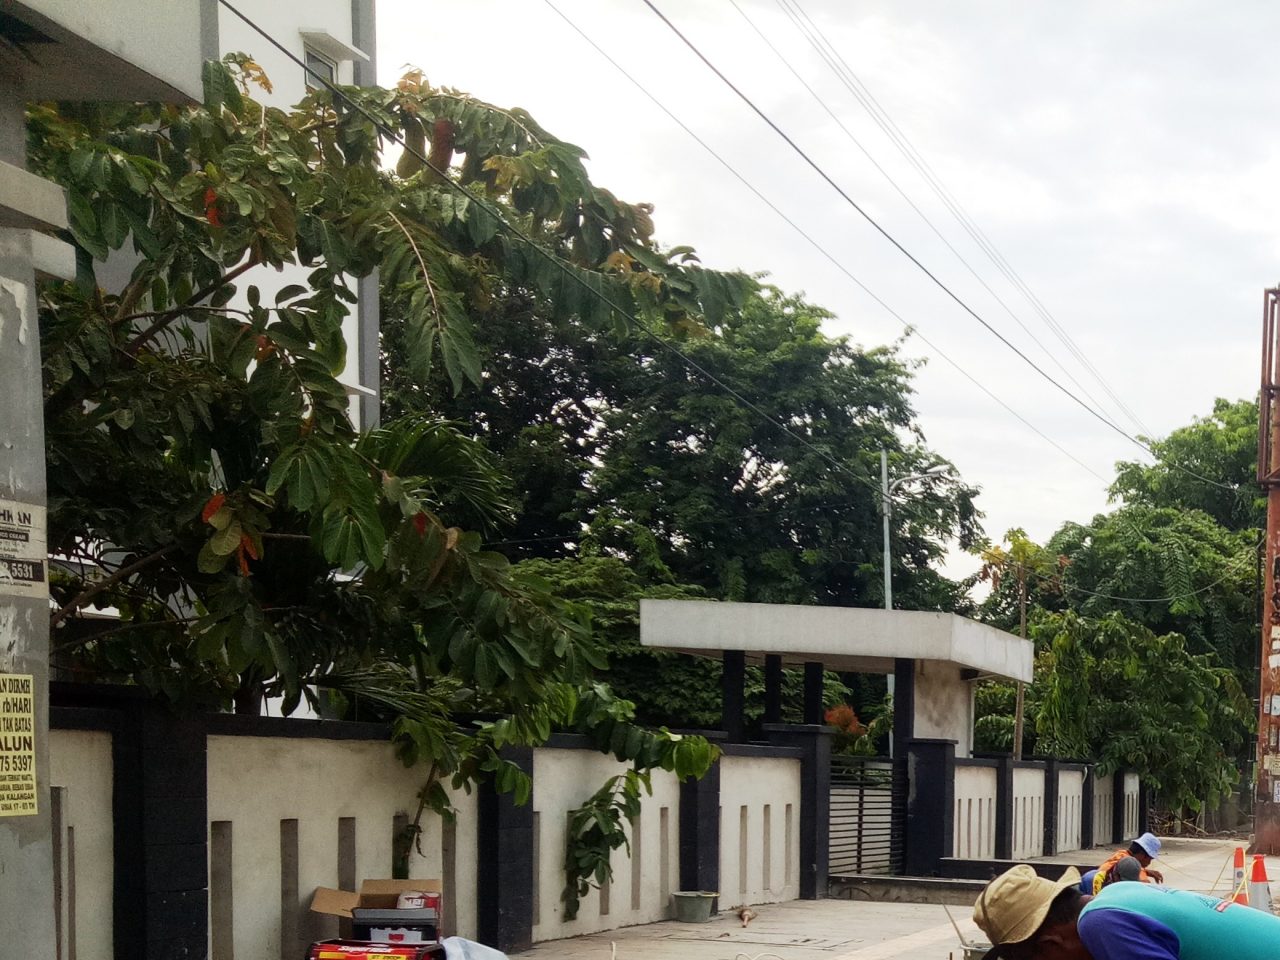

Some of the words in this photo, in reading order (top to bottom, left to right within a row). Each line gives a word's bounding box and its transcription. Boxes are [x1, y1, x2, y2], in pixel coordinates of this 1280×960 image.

[3, 717, 13, 732] TAK
[15, 717, 32, 732] BATAS
[13, 755, 33, 771] 5397
